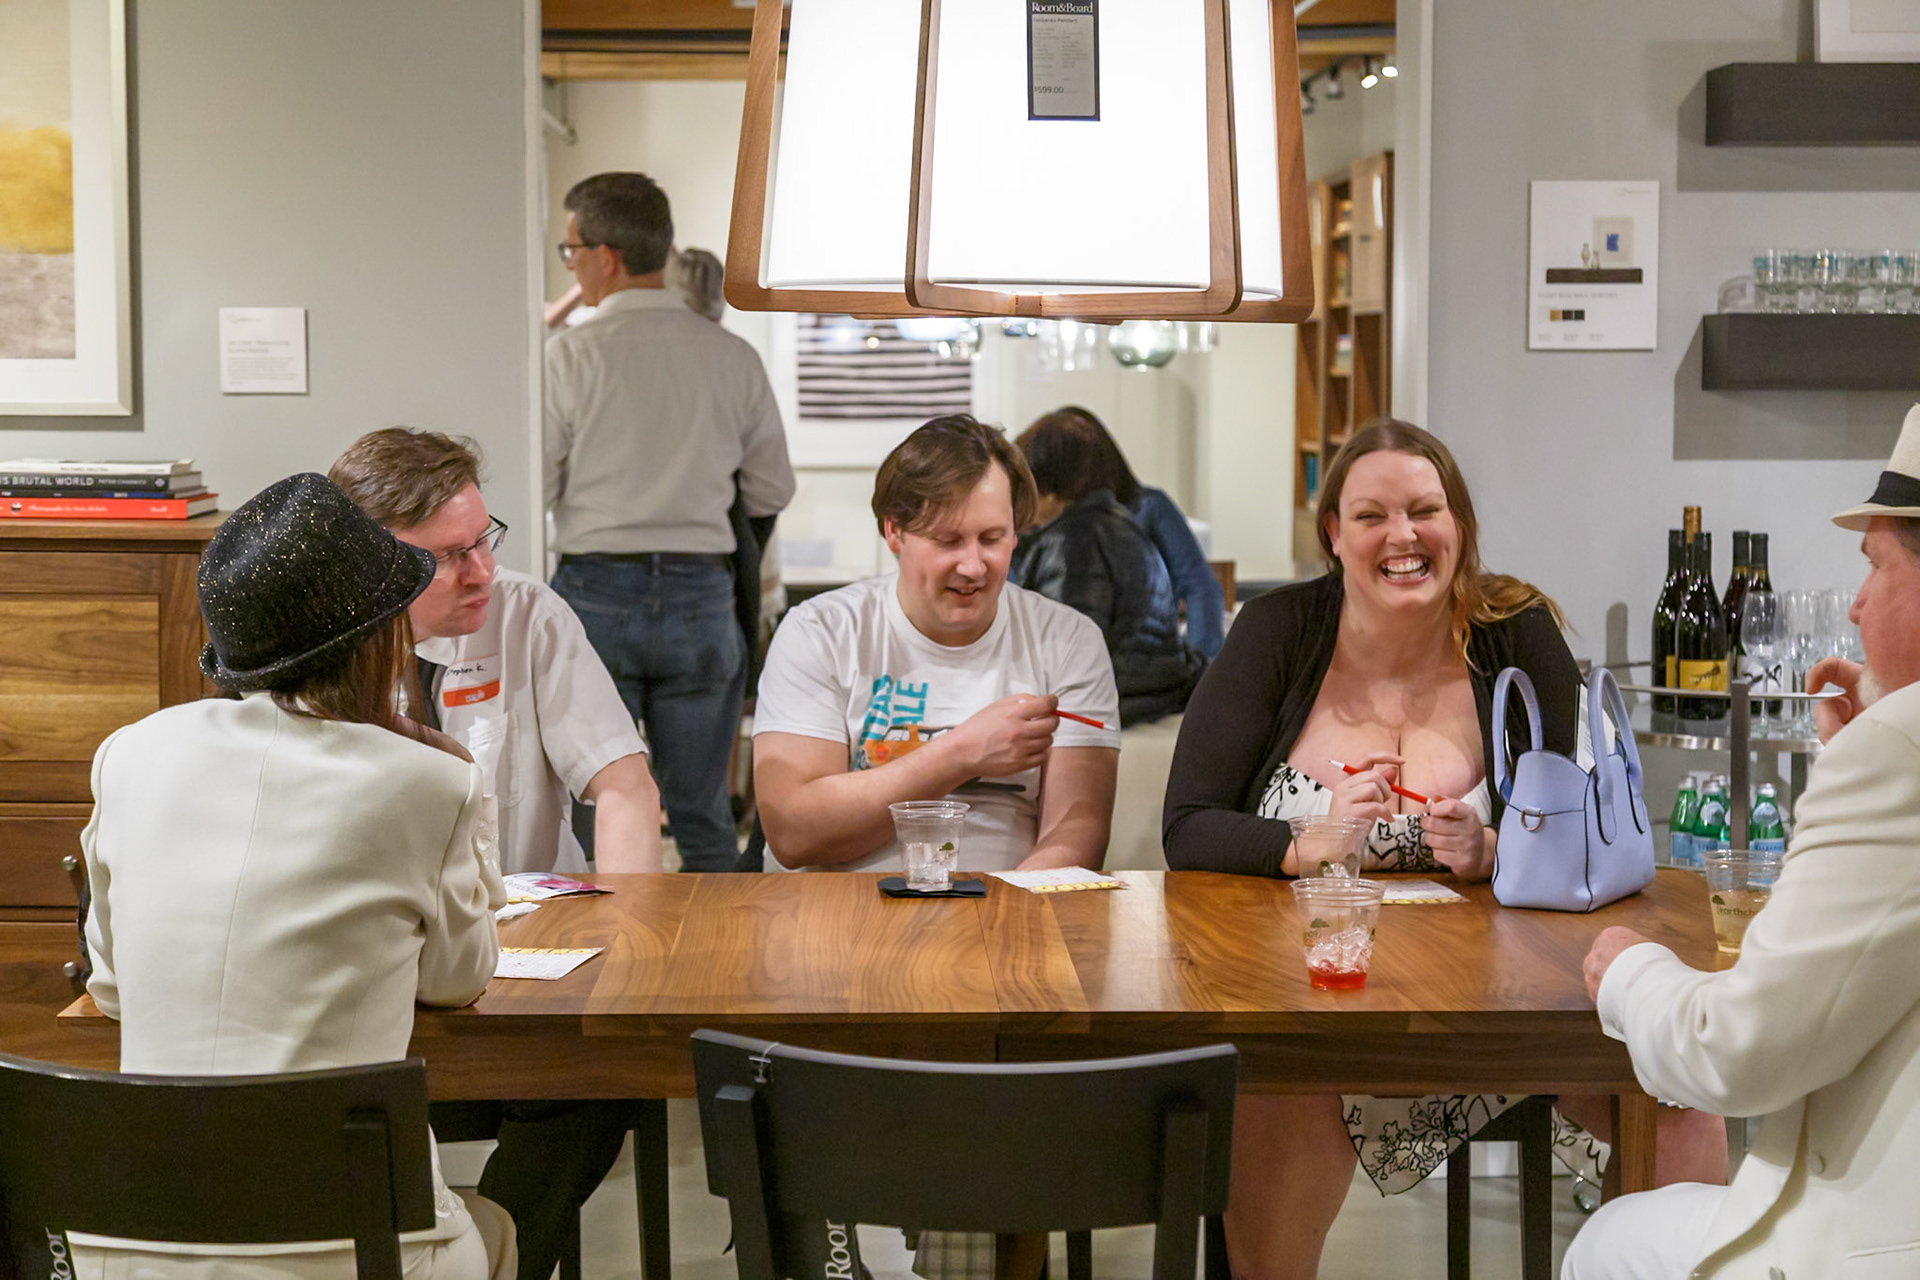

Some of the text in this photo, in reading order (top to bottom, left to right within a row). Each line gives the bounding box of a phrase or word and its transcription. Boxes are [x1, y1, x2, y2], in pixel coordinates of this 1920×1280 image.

[1031, 2, 1093, 13] Room&Board
[12, 476, 52, 486] BRUTAL
[55, 476, 94, 486] WORLD
